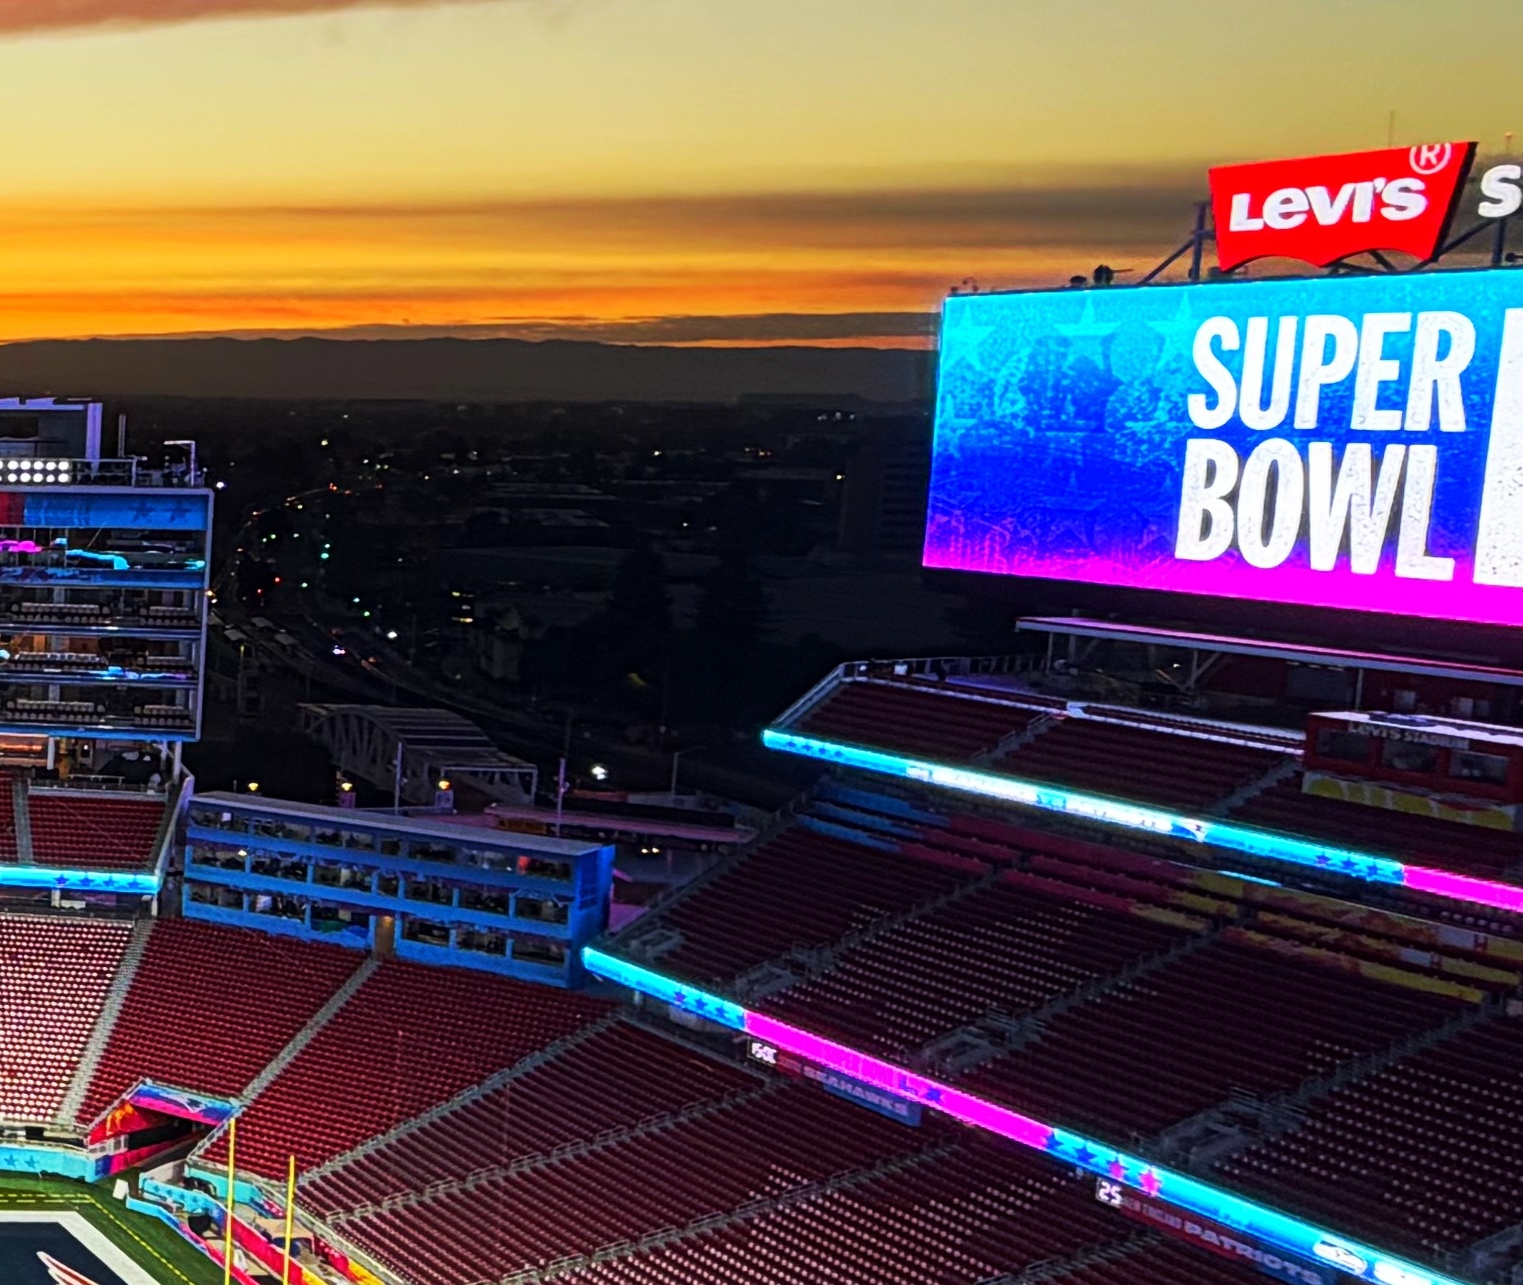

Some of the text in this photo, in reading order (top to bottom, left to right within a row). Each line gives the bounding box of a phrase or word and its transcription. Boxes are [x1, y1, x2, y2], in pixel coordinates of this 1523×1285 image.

[1187, 310, 1477, 432] SUPER
[1174, 437, 1455, 581] BOWL
[1098, 1181, 1122, 1206] 25
